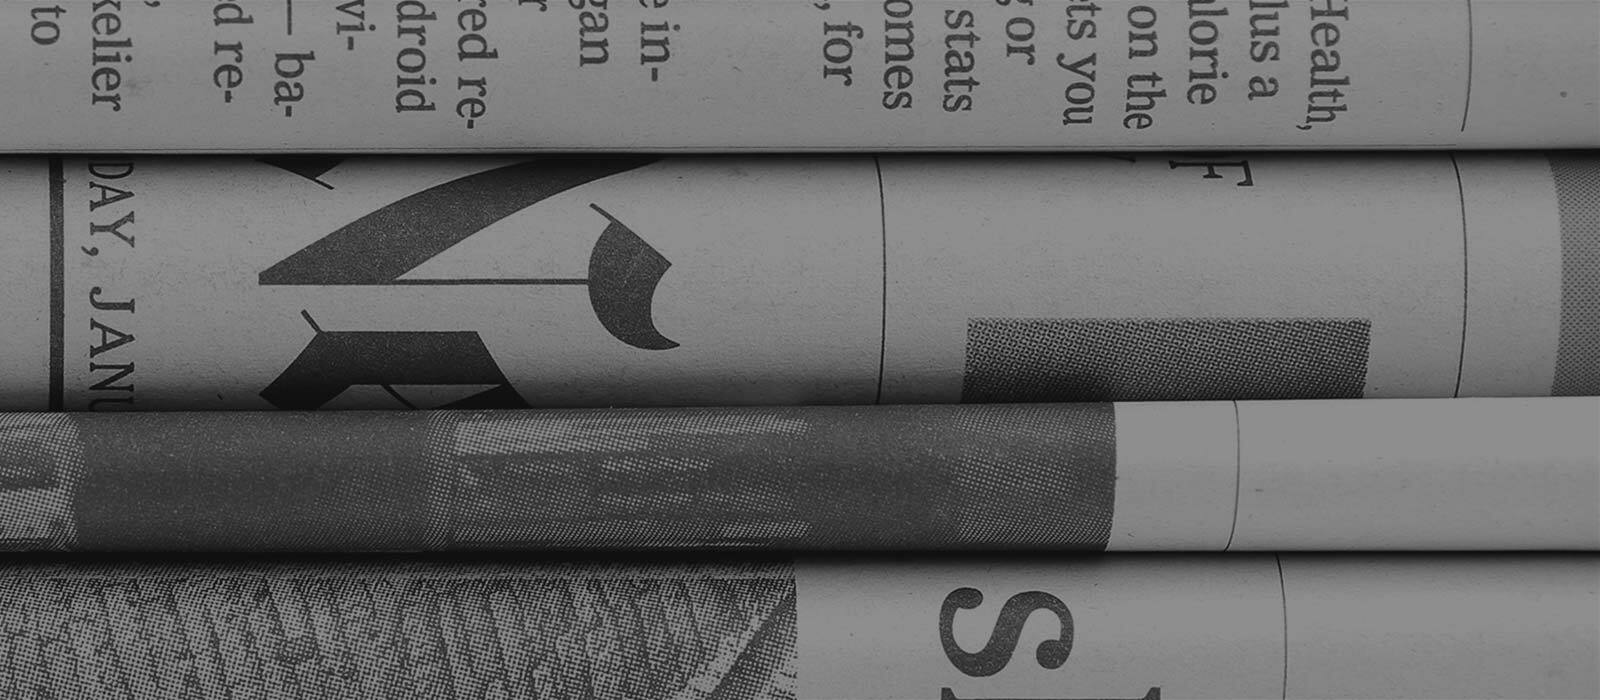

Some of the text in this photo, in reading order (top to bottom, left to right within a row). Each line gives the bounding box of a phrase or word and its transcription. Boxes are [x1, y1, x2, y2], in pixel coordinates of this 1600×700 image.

[30, 4, 67, 46] to
[335, 0, 377, 51] vi-
[395, 0, 438, 114] droid
[640, 21, 681, 82] in-
[822, 21, 864, 87] for
[881, 0, 915, 110] omes
[1005, 16, 1036, 66] or
[1186, 0, 1230, 105] lorie
[212, 40, 244, 104] re-
[273, 50, 316, 118] ba-
[942, 9, 981, 113] stats
[1056, 0, 1101, 126] ts you
[1122, 5, 1168, 130] on the
[1247, 75, 1279, 101] a
[1295, 0, 1351, 131] Health,
[455, 76, 487, 130] re-
[79, 162, 135, 257] DAY,
